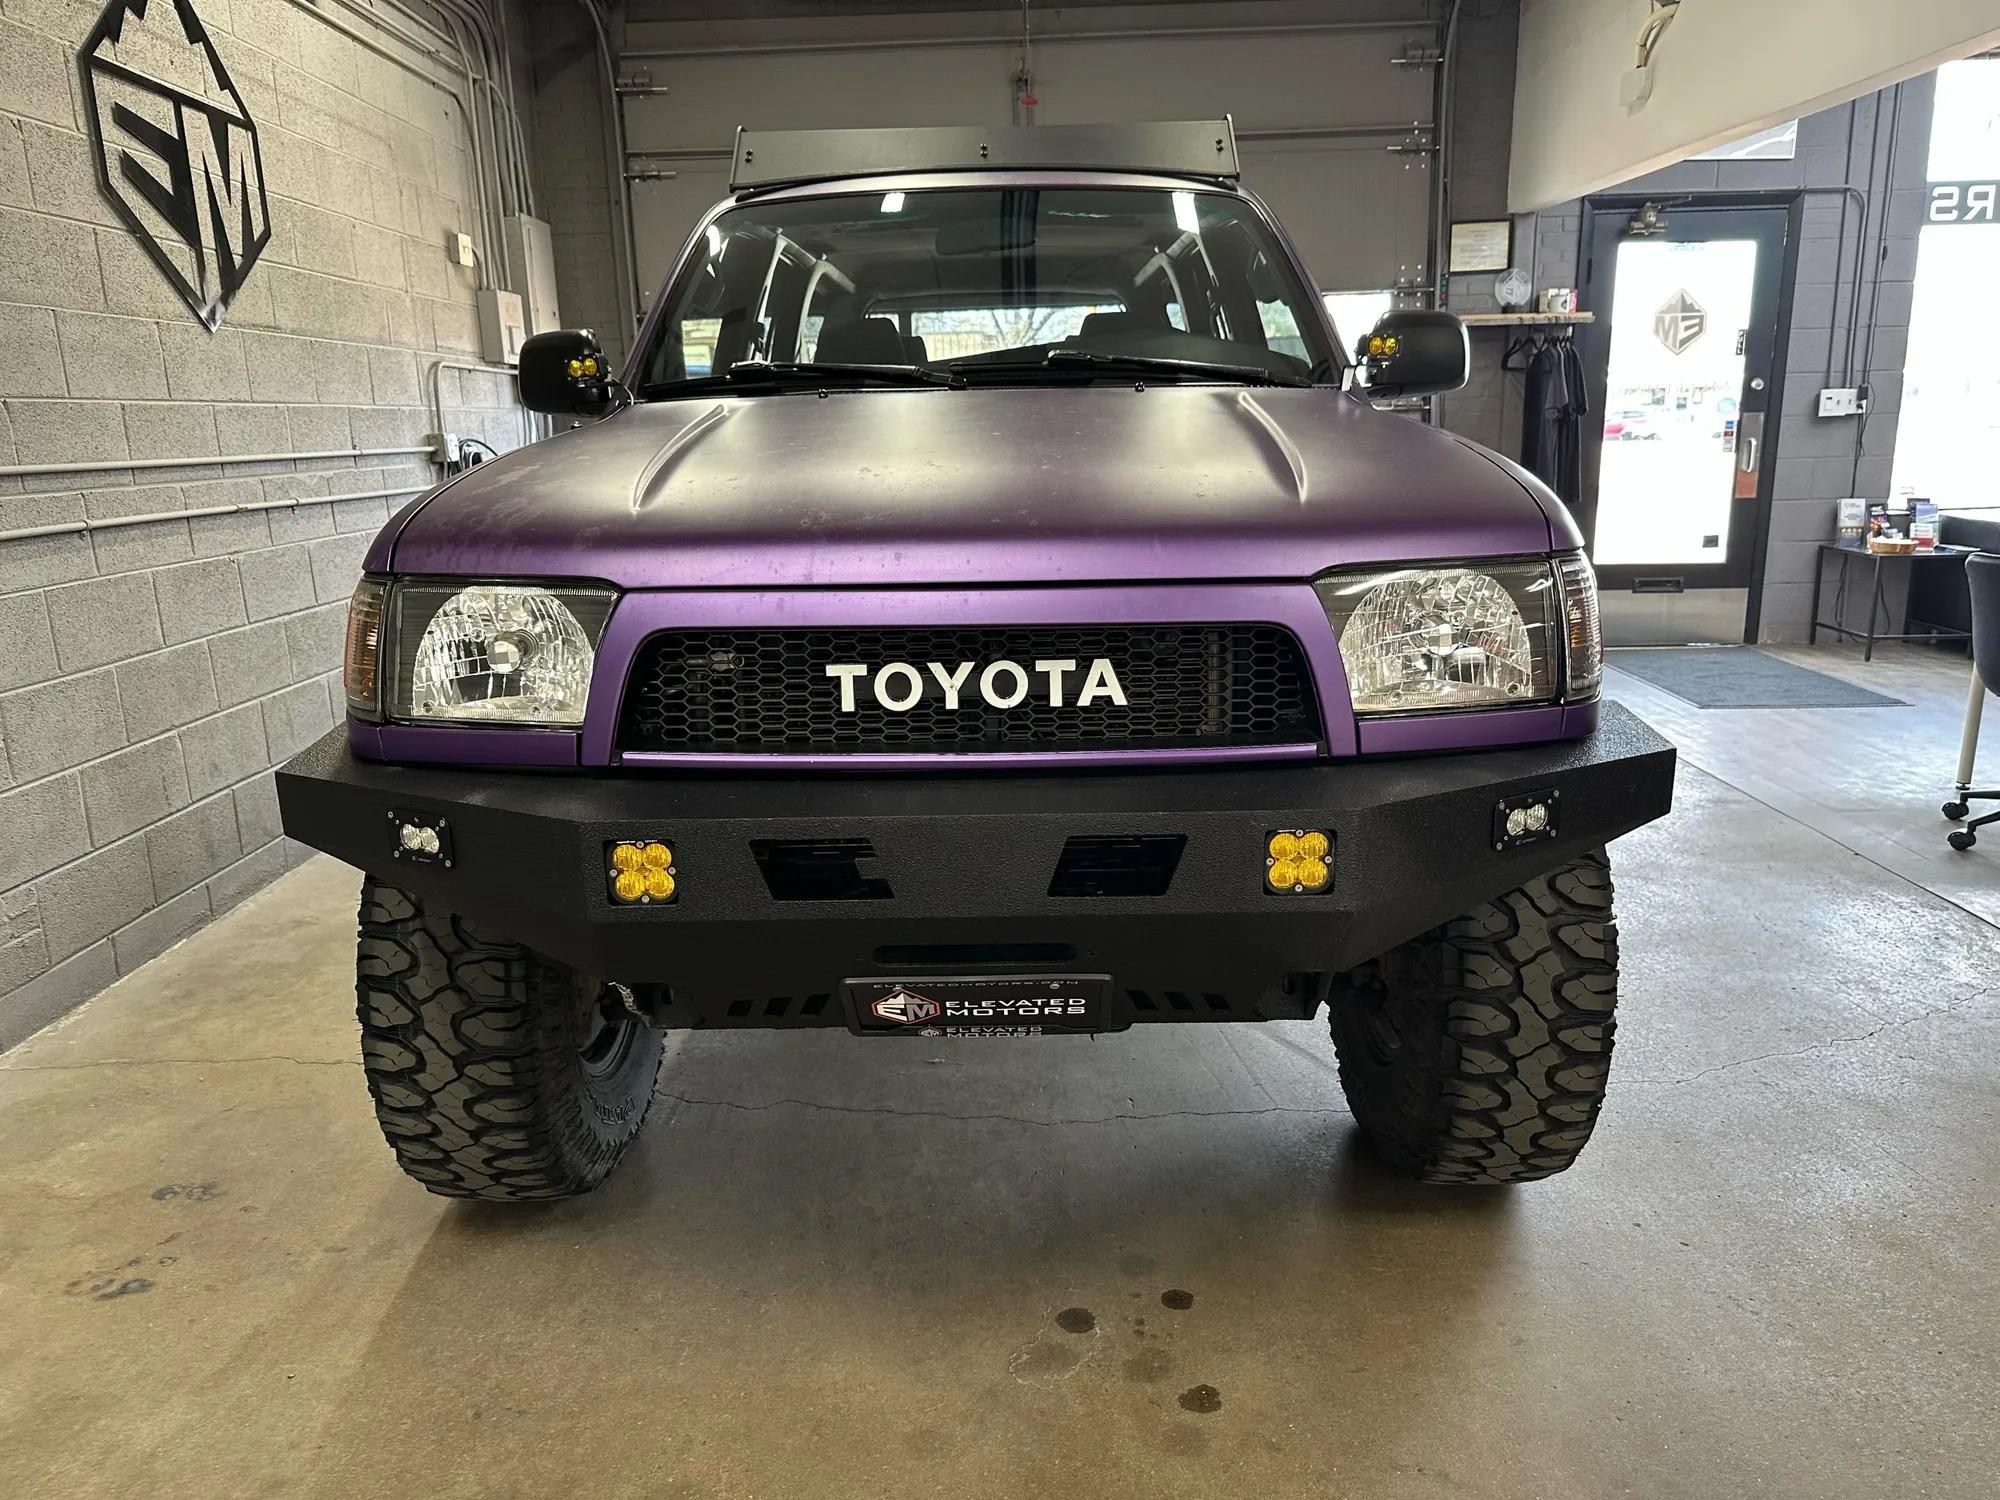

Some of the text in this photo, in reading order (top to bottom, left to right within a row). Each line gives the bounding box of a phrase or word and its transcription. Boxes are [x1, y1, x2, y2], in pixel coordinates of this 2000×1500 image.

[826, 658, 1128, 712] TOYOTA
[945, 998, 1086, 1008] ELEVATED
[946, 1006, 1086, 1016] MOTORS
